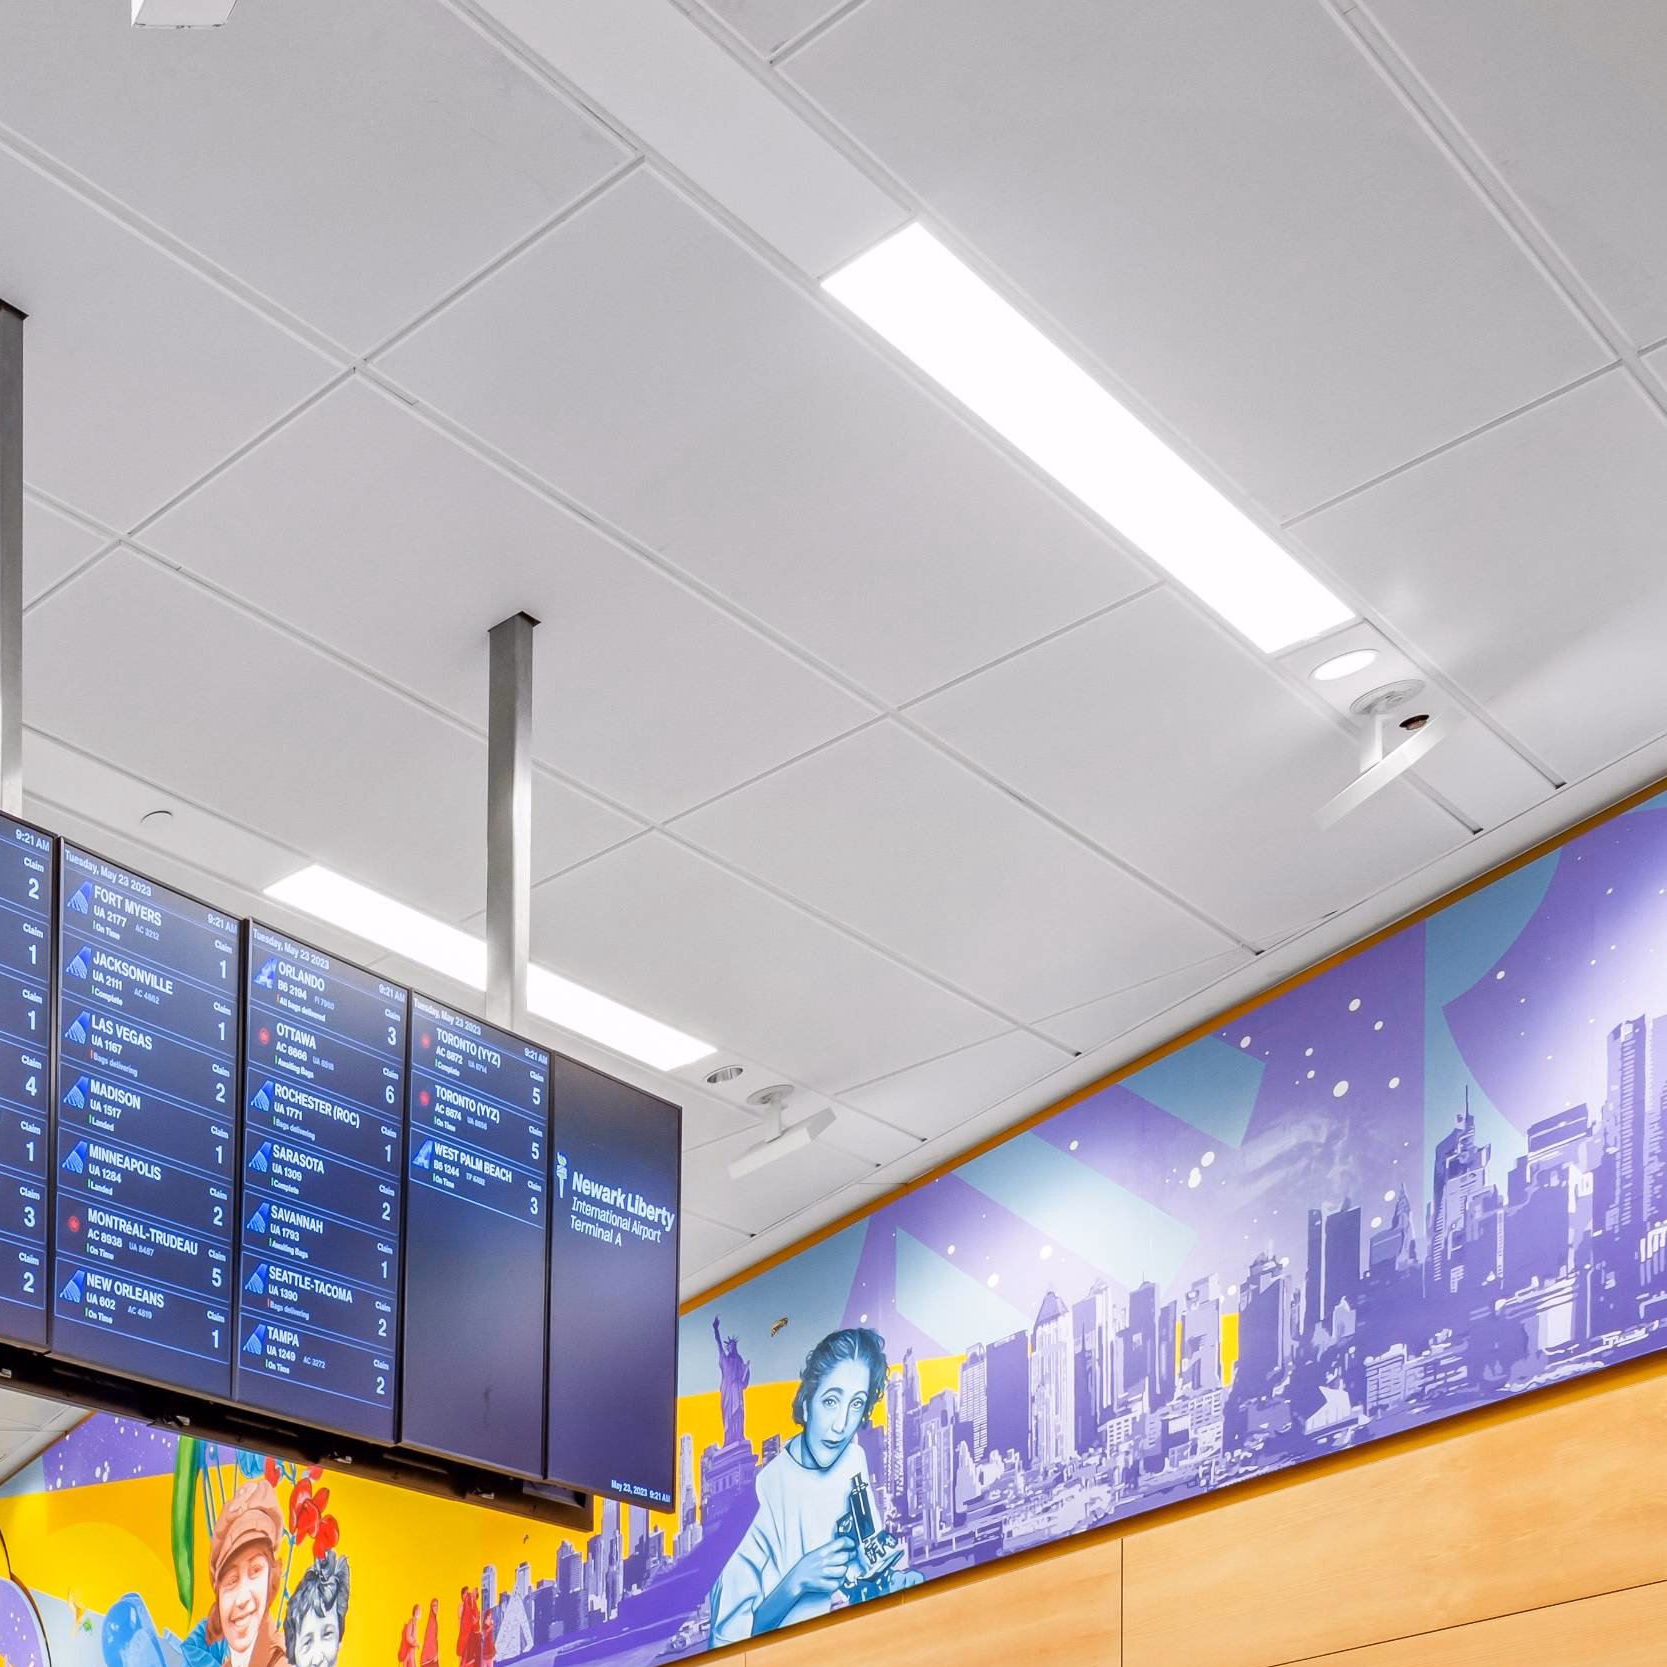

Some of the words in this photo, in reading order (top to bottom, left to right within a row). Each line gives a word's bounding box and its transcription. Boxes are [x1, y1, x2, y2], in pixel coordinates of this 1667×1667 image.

[15, 828, 34, 845] 9:21
[35, 837, 49, 851] AM
[28, 877, 39, 899] 2
[93, 904, 105, 919] UA
[107, 911, 127, 927] 2177
[94, 885, 123, 908] FORT
[124, 898, 161, 926] MYERS
[28, 944, 36, 964] 1
[92, 969, 104, 983] UA
[105, 975, 122, 990] 2111
[93, 951, 173, 994] JACKSONVILLE
[219, 960, 226, 978] 1
[278, 961, 324, 991] ORLANDO
[277, 979, 288, 992] B6
[27, 1010, 35, 1030] 1
[91, 1014, 113, 1034] LAS
[115, 1023, 152, 1050] VEGAS
[218, 1022, 224, 1040] 1
[276, 1022, 316, 1049] OTTAWA
[387, 1026, 396, 1045] 3
[91, 1034, 103, 1048] UA
[104, 1039, 122, 1054] 1167
[436, 1027, 476, 1055] TORONTO
[477, 1045, 500, 1068] (YYZ)
[25, 1076, 37, 1096] 4
[90, 1079, 140, 1109] MADISON
[215, 1082, 225, 1103] 2
[385, 1085, 394, 1103] 6
[90, 1098, 101, 1112] UA
[103, 1104, 121, 1118] 1517
[274, 1082, 332, 1116] ROCHESTER
[333, 1105, 359, 1128] (ROC)
[274, 1101, 284, 1114] UA
[285, 1106, 302, 1120] 1771
[434, 1084, 476, 1112] TORONTO
[476, 1102, 499, 1123] (YYZ)
[26, 1141, 33, 1161] 1
[89, 1143, 161, 1180] MINNEAPOLIS
[215, 1145, 222, 1163] 1
[272, 1144, 324, 1173] SARASOTA
[272, 1162, 282, 1175] UA
[434, 1141, 459, 1161] WEST
[460, 1152, 482, 1171] PALM
[483, 1161, 511, 1183] BEACH
[88, 1163, 100, 1176] UA
[101, 1168, 121, 1183] 1284
[572, 1171, 625, 1210] Newark
[627, 1188, 675, 1232] Liberty
[24, 1206, 35, 1227] 3
[213, 1206, 222, 1226] 2
[270, 1205, 323, 1233] SAVANNAH
[571, 1199, 630, 1231] International
[631, 1220, 662, 1243] Airport
[87, 1228, 99, 1240] AC
[100, 1232, 122, 1247] 8938
[270, 1223, 280, 1235] UA
[281, 1227, 299, 1241] 1793
[570, 1215, 613, 1243] Terminal
[614, 1233, 623, 1246] A
[23, 1271, 34, 1293] 2
[211, 1267, 221, 1287] 5
[268, 1265, 352, 1303] SEATTLE-TACOMA
[86, 1272, 112, 1291] NEW
[113, 1281, 164, 1308] ORLEANS
[268, 1284, 278, 1296] UA
[279, 1287, 297, 1301] 1390
[86, 1292, 98, 1305] UA
[99, 1296, 115, 1310] 602
[211, 1329, 218, 1348] 1
[267, 1325, 299, 1347] TAMPA
[266, 1344, 277, 1356] UA
[278, 1348, 295, 1361] 1249
[623, 1483, 633, 1495] 23,
[632, 1485, 648, 1497] 2023
[649, 1489, 661, 1500] 9:21
